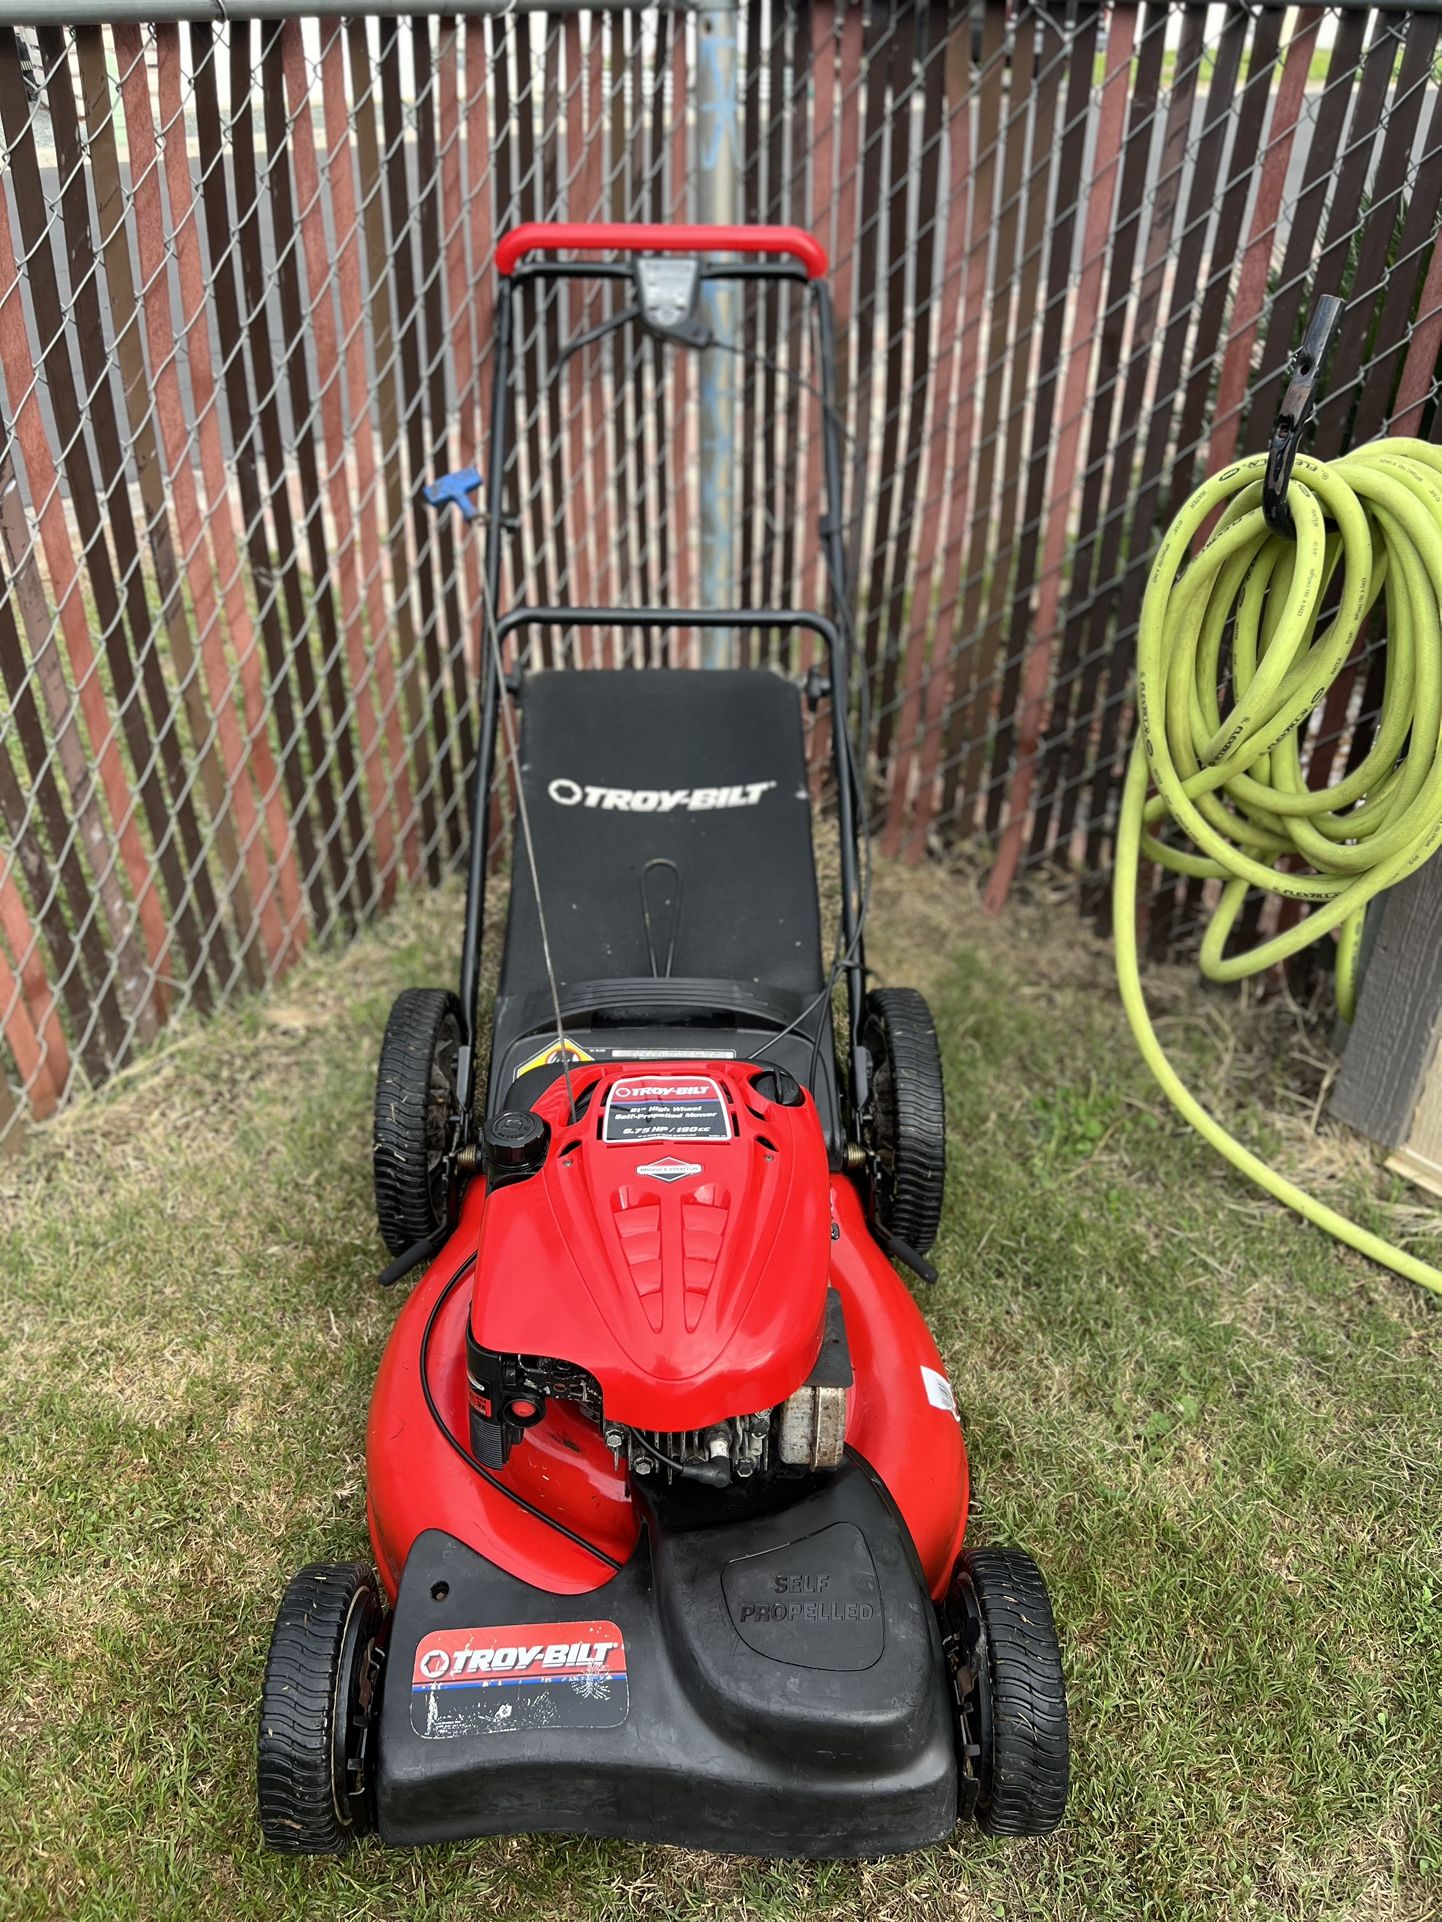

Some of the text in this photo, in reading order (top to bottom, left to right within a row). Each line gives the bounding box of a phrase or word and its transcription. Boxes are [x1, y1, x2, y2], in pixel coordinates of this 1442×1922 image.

[1190, 490, 1207, 509] WATER
[1311, 508, 1319, 528] WATER
[1331, 657, 1342, 675] WATER
[1140, 682, 1150, 733] FLEXZILLA
[584, 781, 769, 812] TROY-BILT
[631, 1086, 710, 1097] TROY-BILT
[614, 1112, 683, 1120] Self-Propelled
[774, 1575, 830, 1593] SELF
[740, 1603, 874, 1622] PROPELLED
[452, 1642, 614, 1674] TROY-BILT
